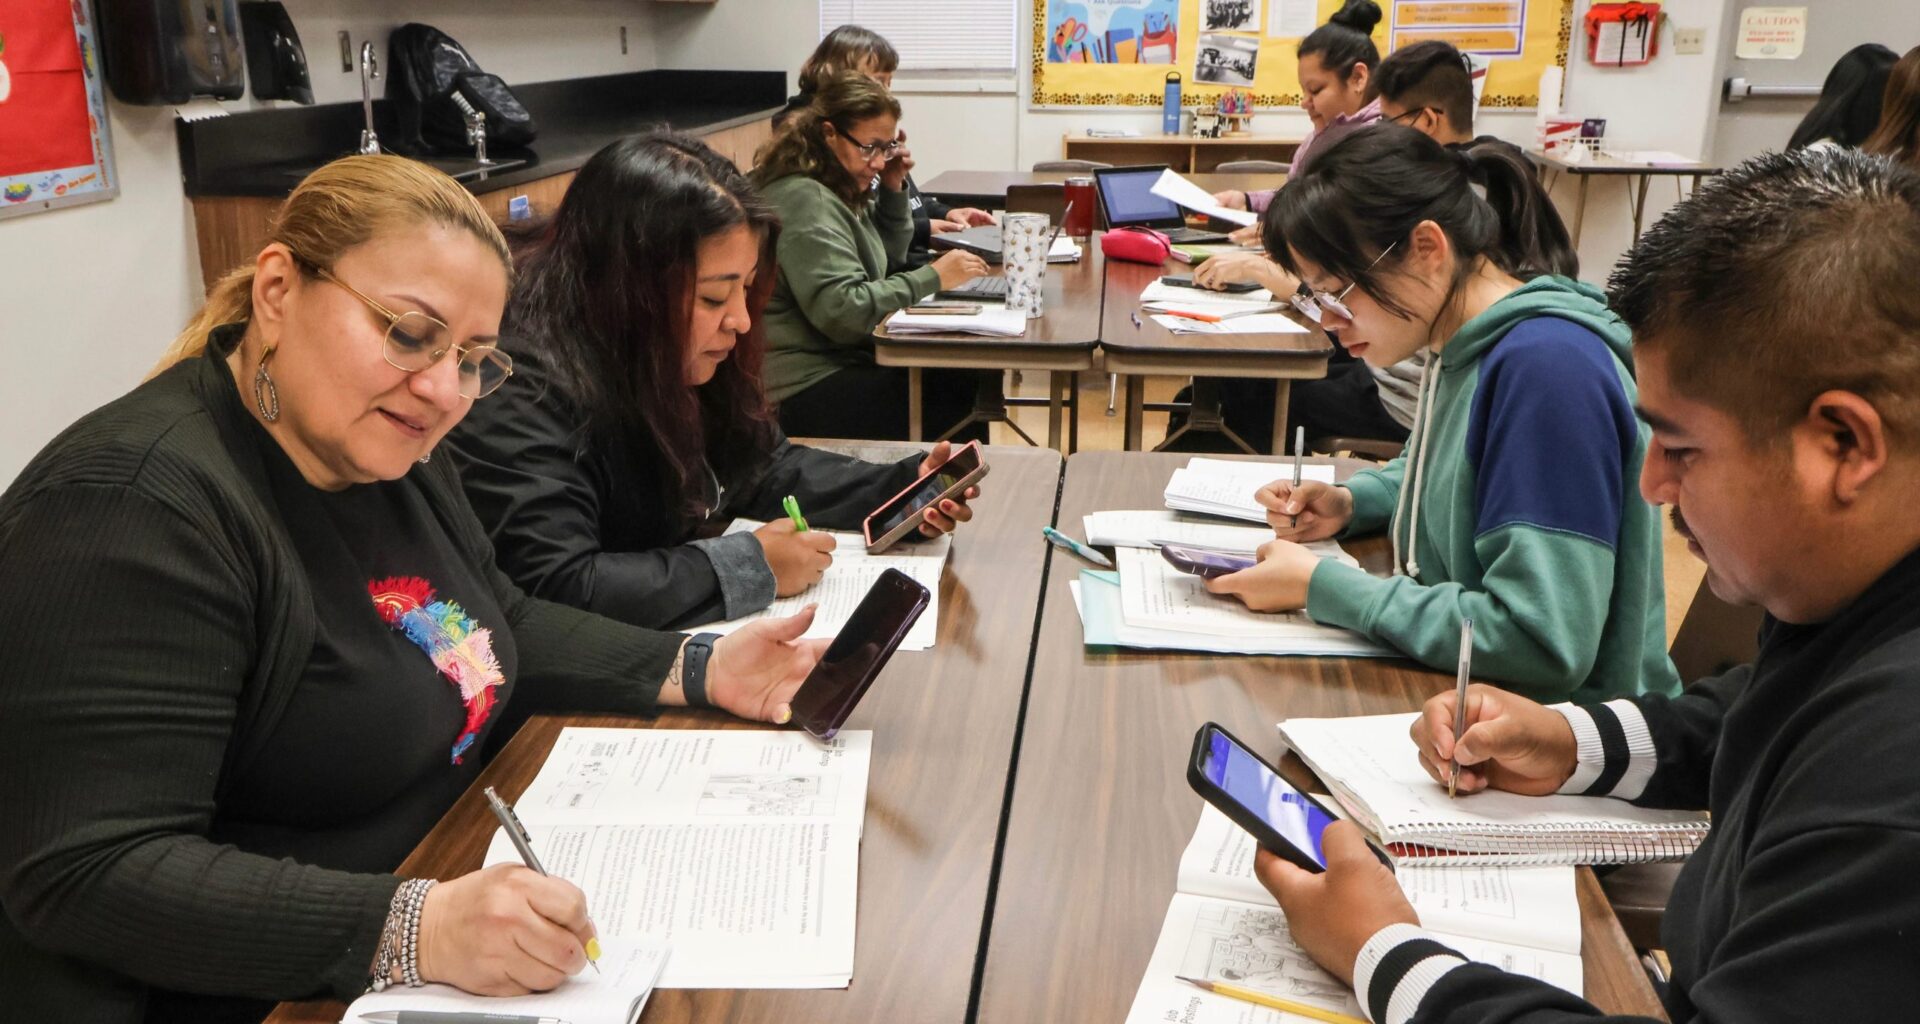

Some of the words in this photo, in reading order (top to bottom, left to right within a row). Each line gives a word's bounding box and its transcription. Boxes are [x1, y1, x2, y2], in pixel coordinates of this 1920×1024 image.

[1746, 17, 1800, 25] CAUTION
[1163, 1009, 1179, 1022] Job
[1180, 996, 1203, 1024] Postings
